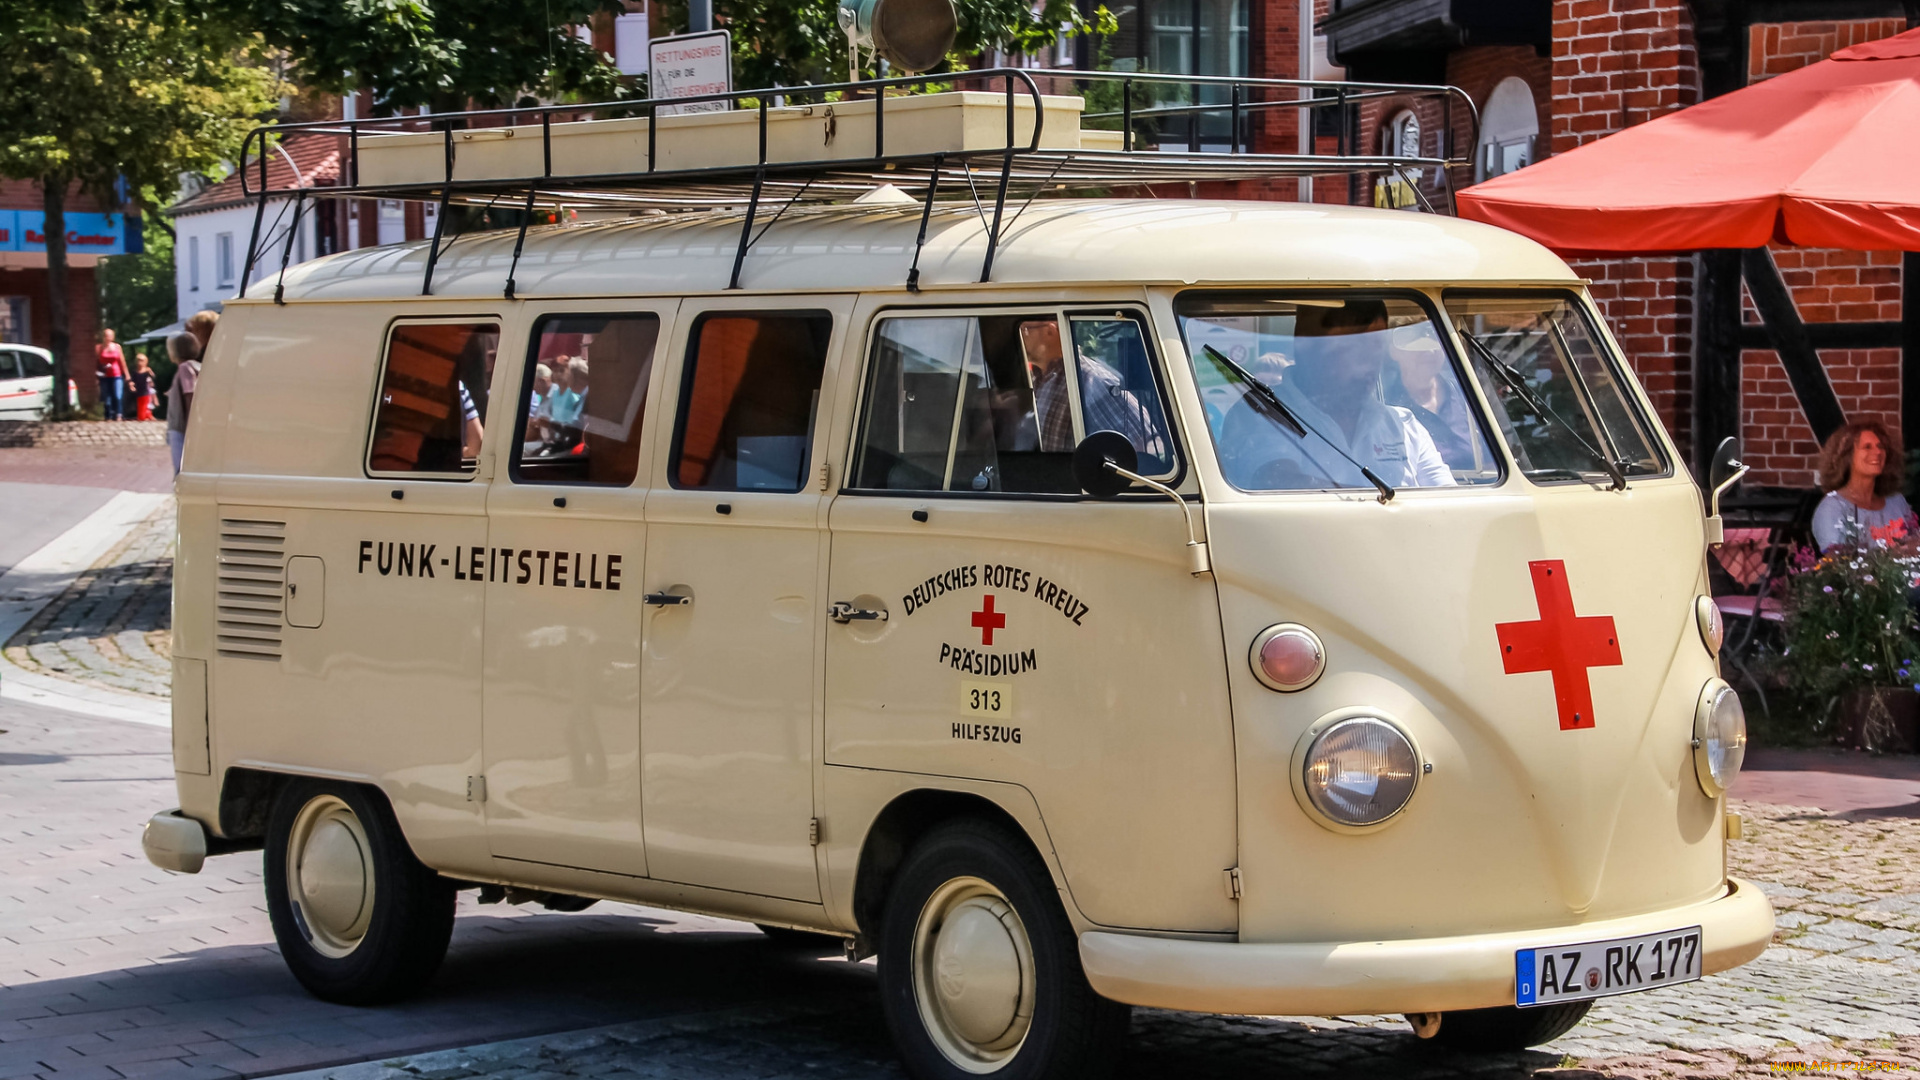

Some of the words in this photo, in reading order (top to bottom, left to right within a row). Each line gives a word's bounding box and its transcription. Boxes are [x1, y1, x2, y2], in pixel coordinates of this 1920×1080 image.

[655, 45, 721, 63] RETTUNGSWEG
[684, 68, 696, 77] DIE
[673, 81, 726, 97] FEUERWEHR
[358, 540, 622, 591] FUNK-LEITSTELLE
[903, 565, 977, 616] DEUTSCHES
[983, 564, 1031, 593] ROTES
[1034, 576, 1090, 627] KREUZ
[939, 642, 1037, 676] PRÄSIDIUM
[970, 689, 1001, 711] 313
[952, 722, 1021, 744] HILFSZUG
[1539, 952, 1582, 996] AZ
[1605, 942, 1644, 988] RK
[1650, 933, 1699, 981] 177
[1522, 983, 1531, 996] D
